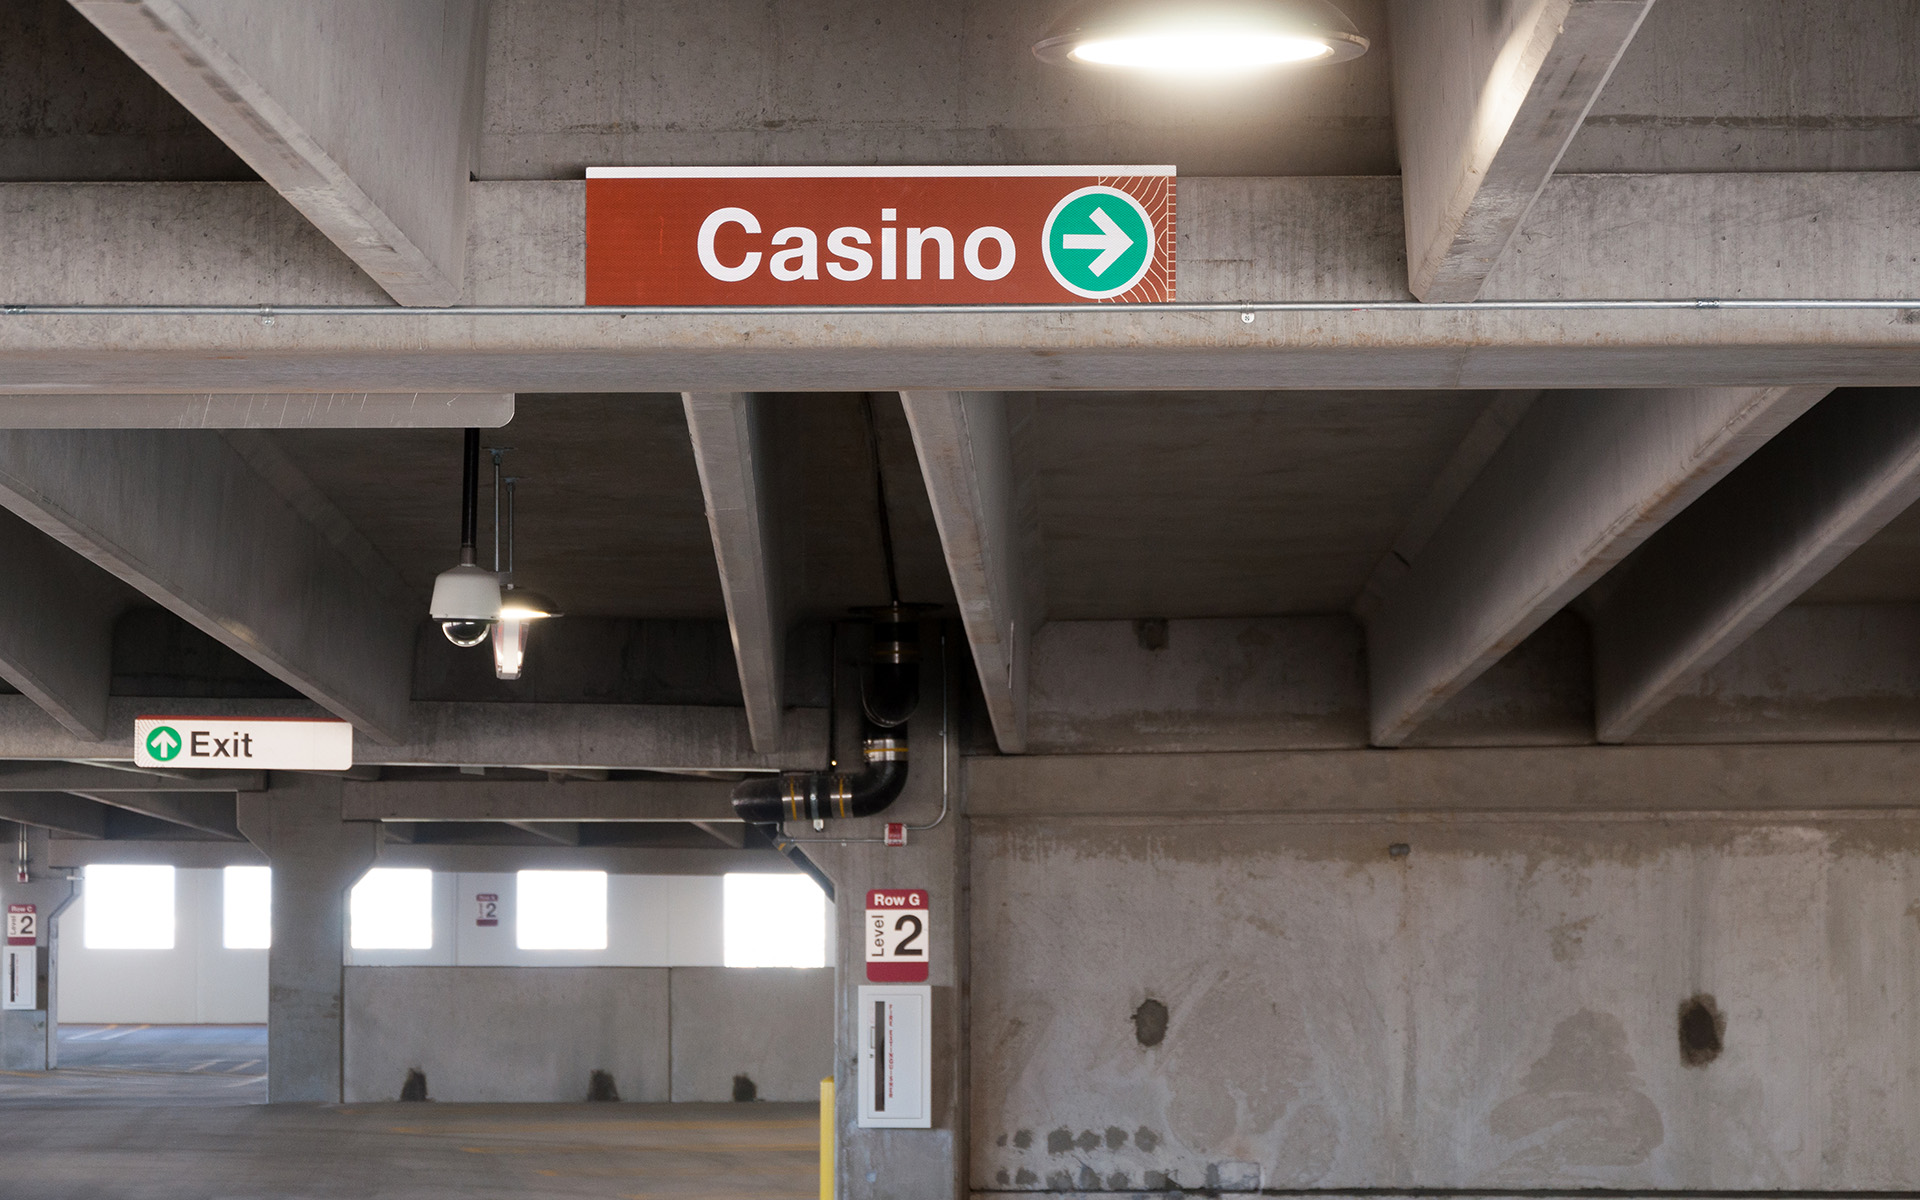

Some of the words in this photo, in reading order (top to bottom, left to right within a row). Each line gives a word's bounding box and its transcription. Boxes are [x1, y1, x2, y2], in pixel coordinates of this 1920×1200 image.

[697, 207, 1016, 282] Casino
[190, 731, 253, 758] Exit
[486, 902, 497, 918] 2
[874, 893, 905, 906] Row
[909, 893, 920, 906] G
[20, 915, 33, 934] 2
[871, 915, 884, 957] Level
[894, 914, 923, 956] 2
